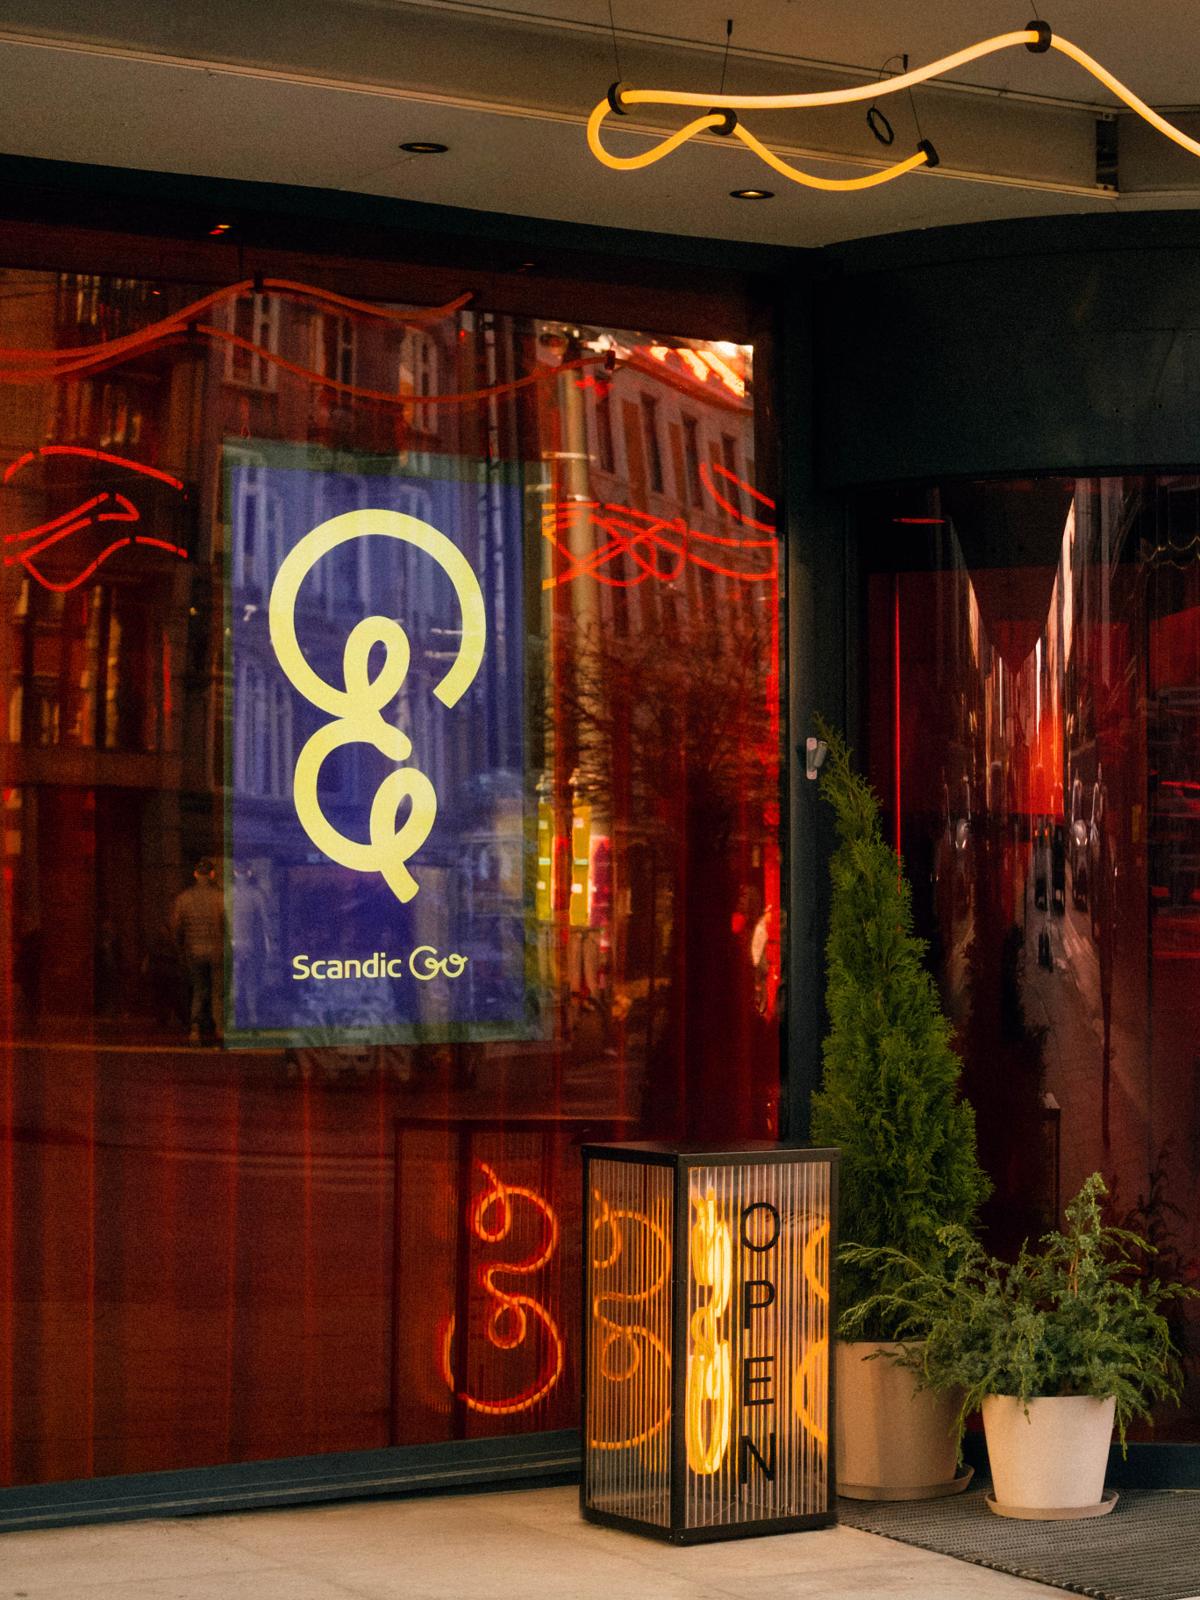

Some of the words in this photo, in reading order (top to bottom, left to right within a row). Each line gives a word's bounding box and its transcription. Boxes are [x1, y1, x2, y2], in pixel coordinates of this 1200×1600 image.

[292, 952, 402, 980] Scandic
[408, 945, 469, 981] Go
[740, 1202, 781, 1485] OPEN
